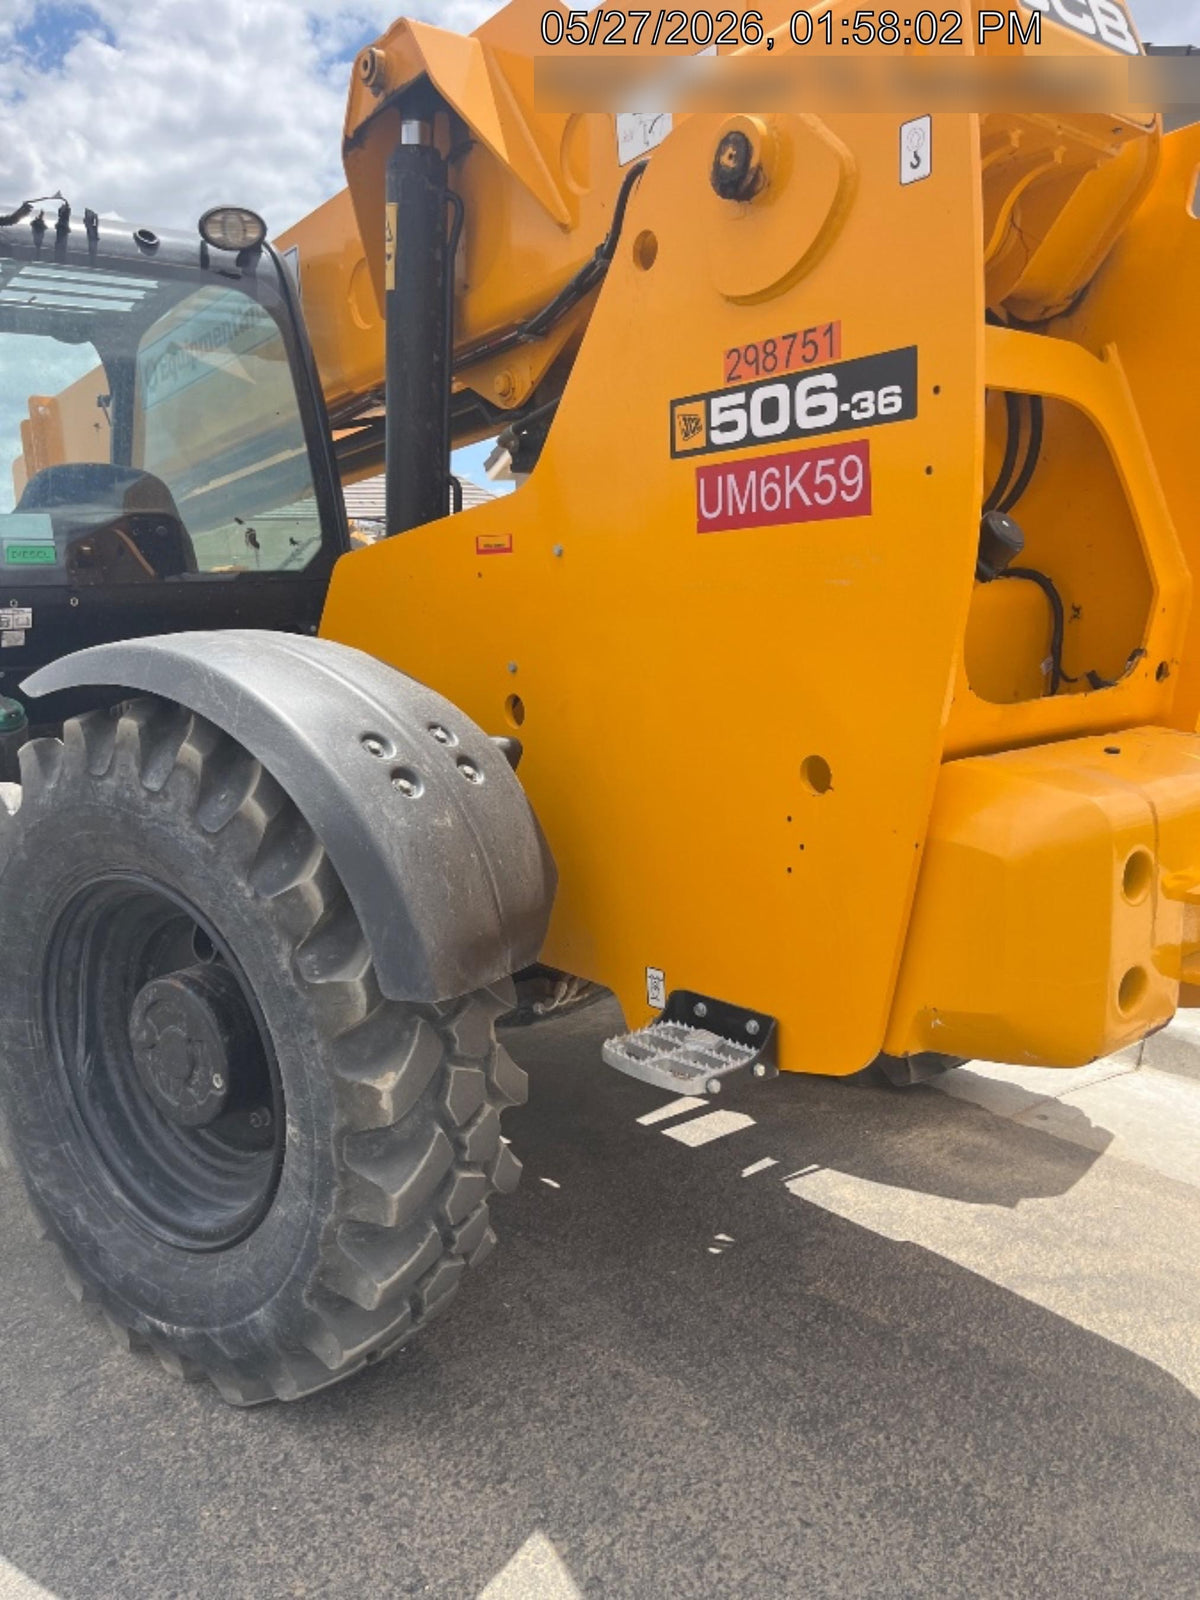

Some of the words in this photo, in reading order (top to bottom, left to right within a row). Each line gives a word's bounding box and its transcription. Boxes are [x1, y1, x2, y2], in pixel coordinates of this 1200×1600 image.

[726, 322, 835, 383] 298751
[710, 373, 903, 445] 506-36
[699, 454, 864, 520] UM6K59
